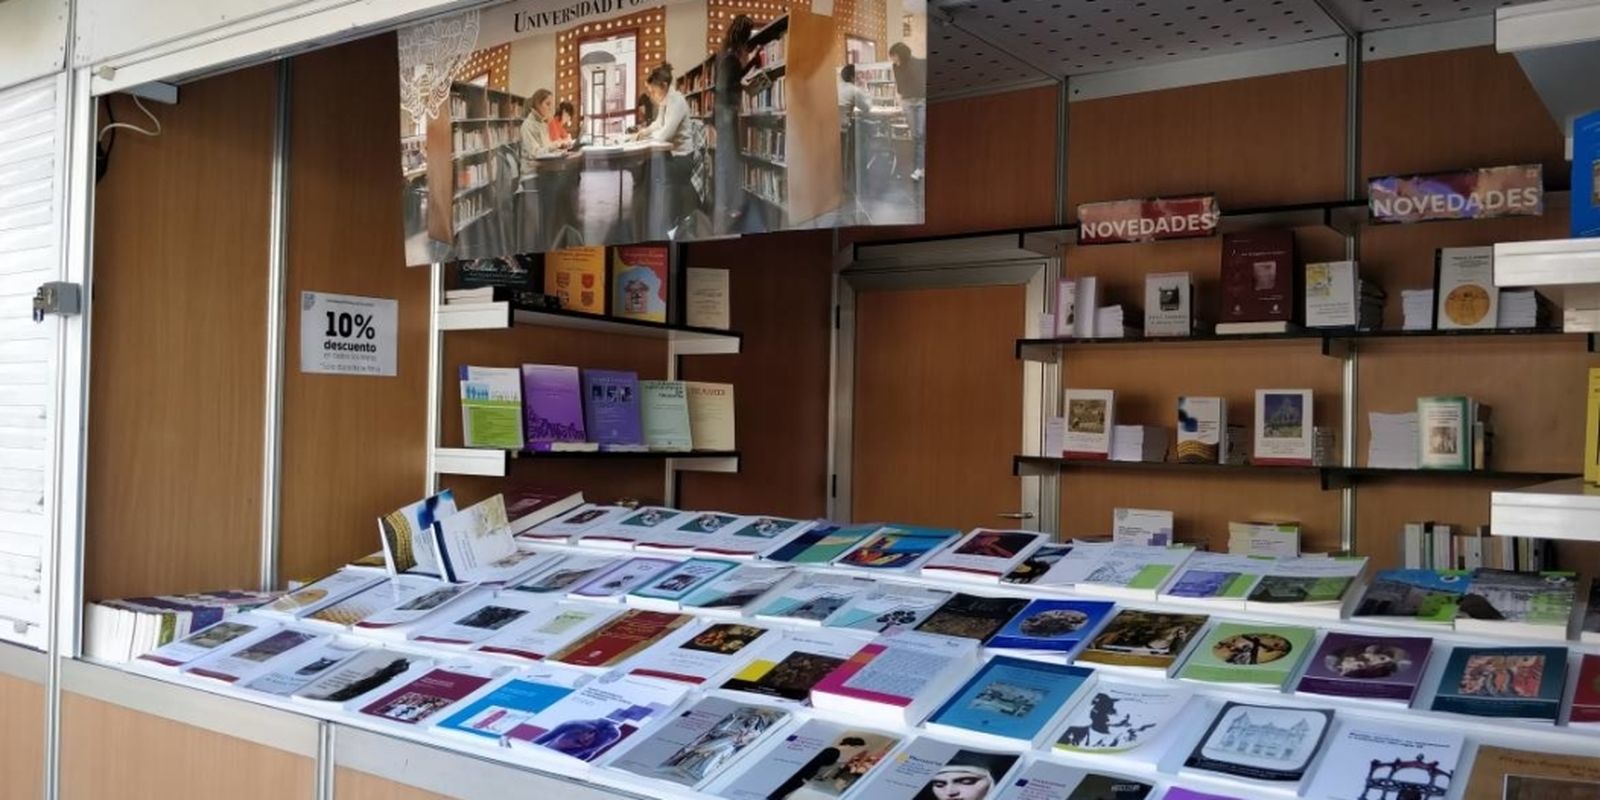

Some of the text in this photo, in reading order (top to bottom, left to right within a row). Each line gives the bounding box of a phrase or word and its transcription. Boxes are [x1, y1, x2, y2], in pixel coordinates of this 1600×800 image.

[514, 0, 612, 33] UNIVERSIDAD
[1373, 187, 1538, 217] NOVEDADES
[1081, 212, 1214, 239] NOVEDADES
[325, 311, 375, 340] 10%
[323, 339, 377, 353] descuento
